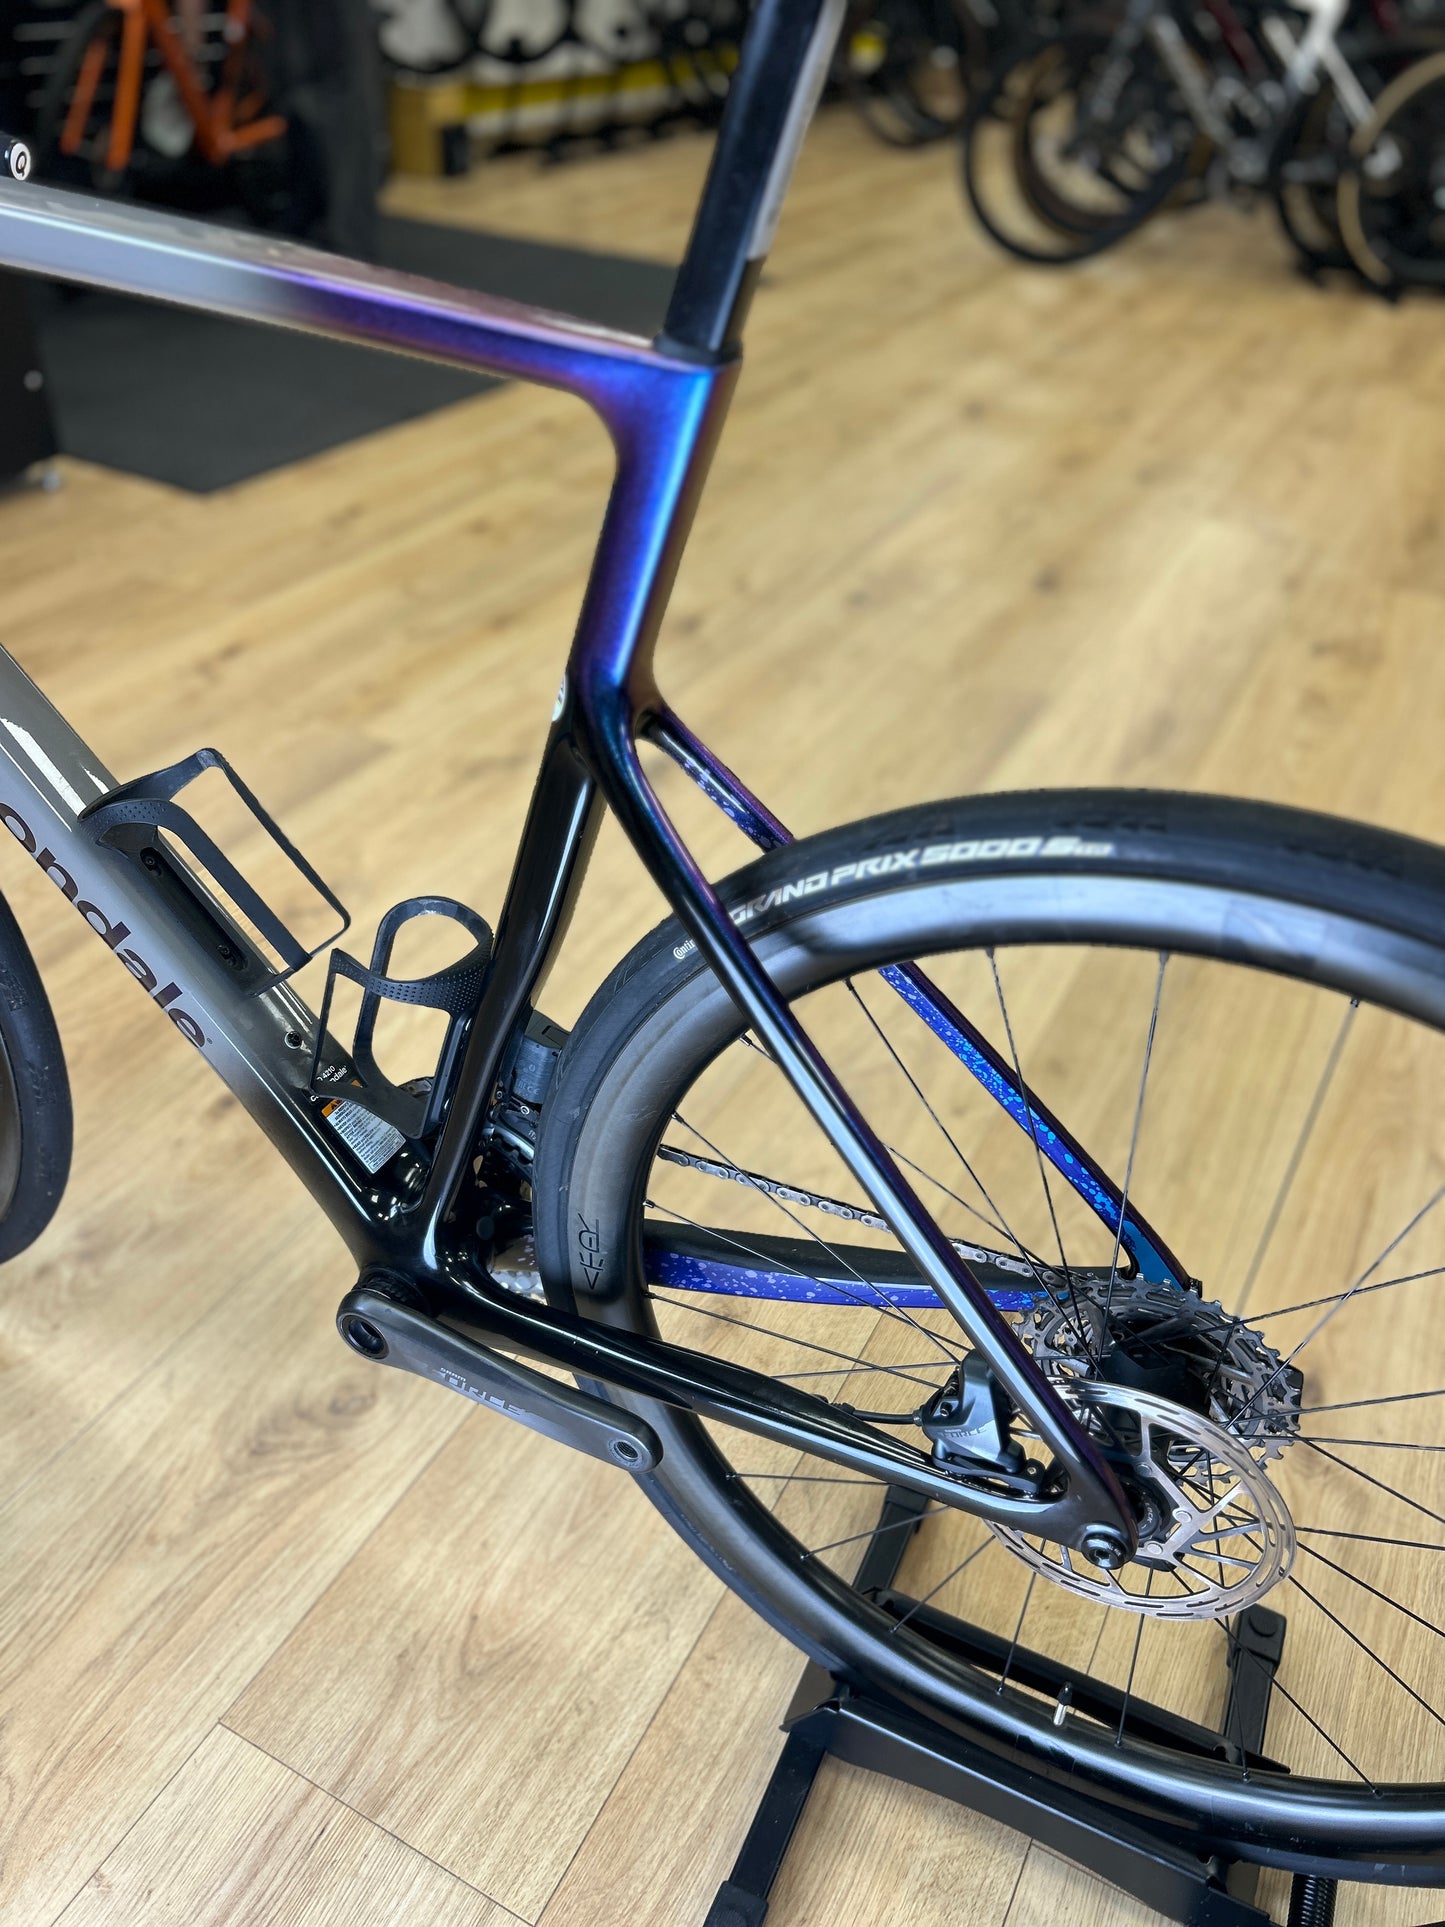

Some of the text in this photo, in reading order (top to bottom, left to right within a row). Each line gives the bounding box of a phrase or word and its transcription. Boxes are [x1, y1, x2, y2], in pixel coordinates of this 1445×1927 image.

[729, 868, 828, 925] GRAND
[829, 847, 920, 886] PRIX
[919, 836, 1043, 865] 5000
